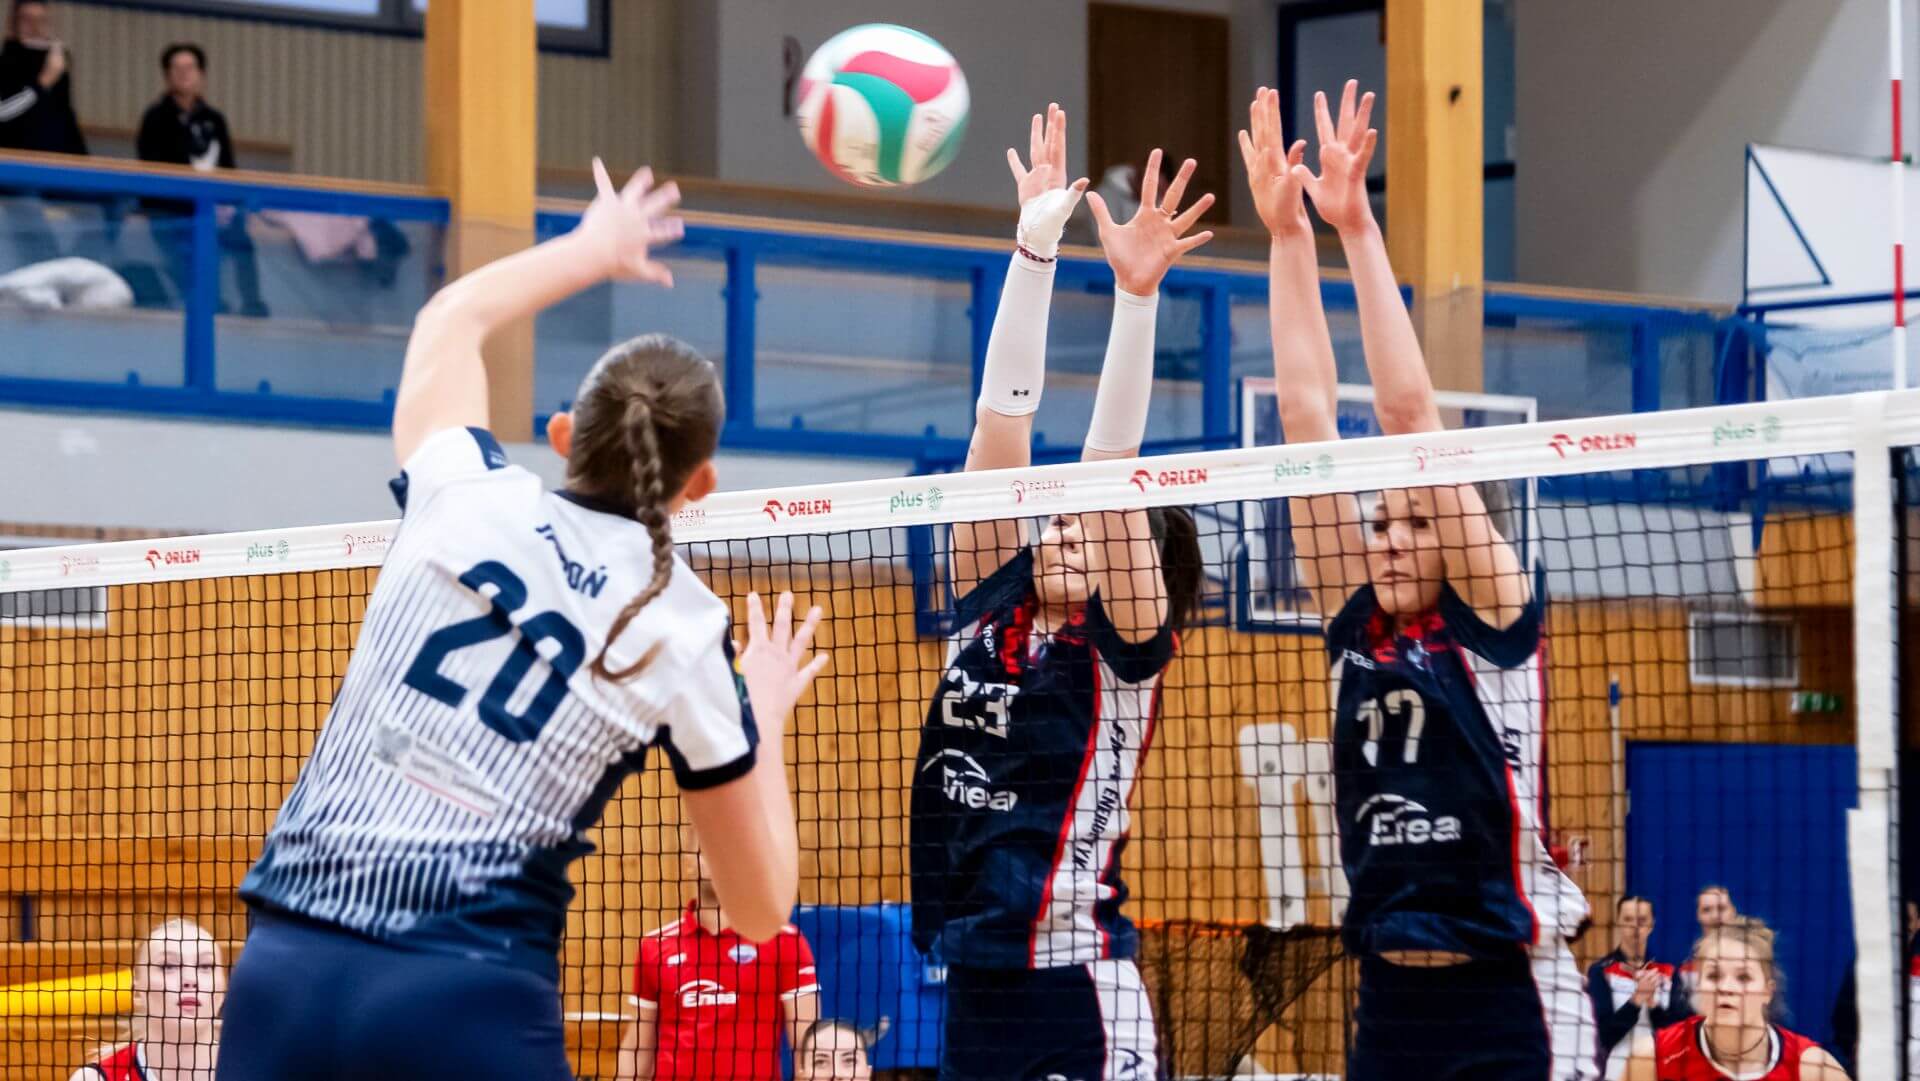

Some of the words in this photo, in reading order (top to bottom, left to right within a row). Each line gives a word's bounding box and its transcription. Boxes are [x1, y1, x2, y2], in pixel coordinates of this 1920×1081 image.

[1580, 433, 1636, 452] ORLEN
[1158, 468, 1208, 487] ORLEN
[1274, 461, 1312, 481] plus
[787, 499, 832, 517] ORLEN
[889, 492, 924, 513] plus
[164, 549, 201, 565] ORLEN
[246, 542, 274, 562] plus
[402, 559, 587, 744] 20
[942, 666, 1021, 740] 23
[1356, 688, 1427, 767] 17
